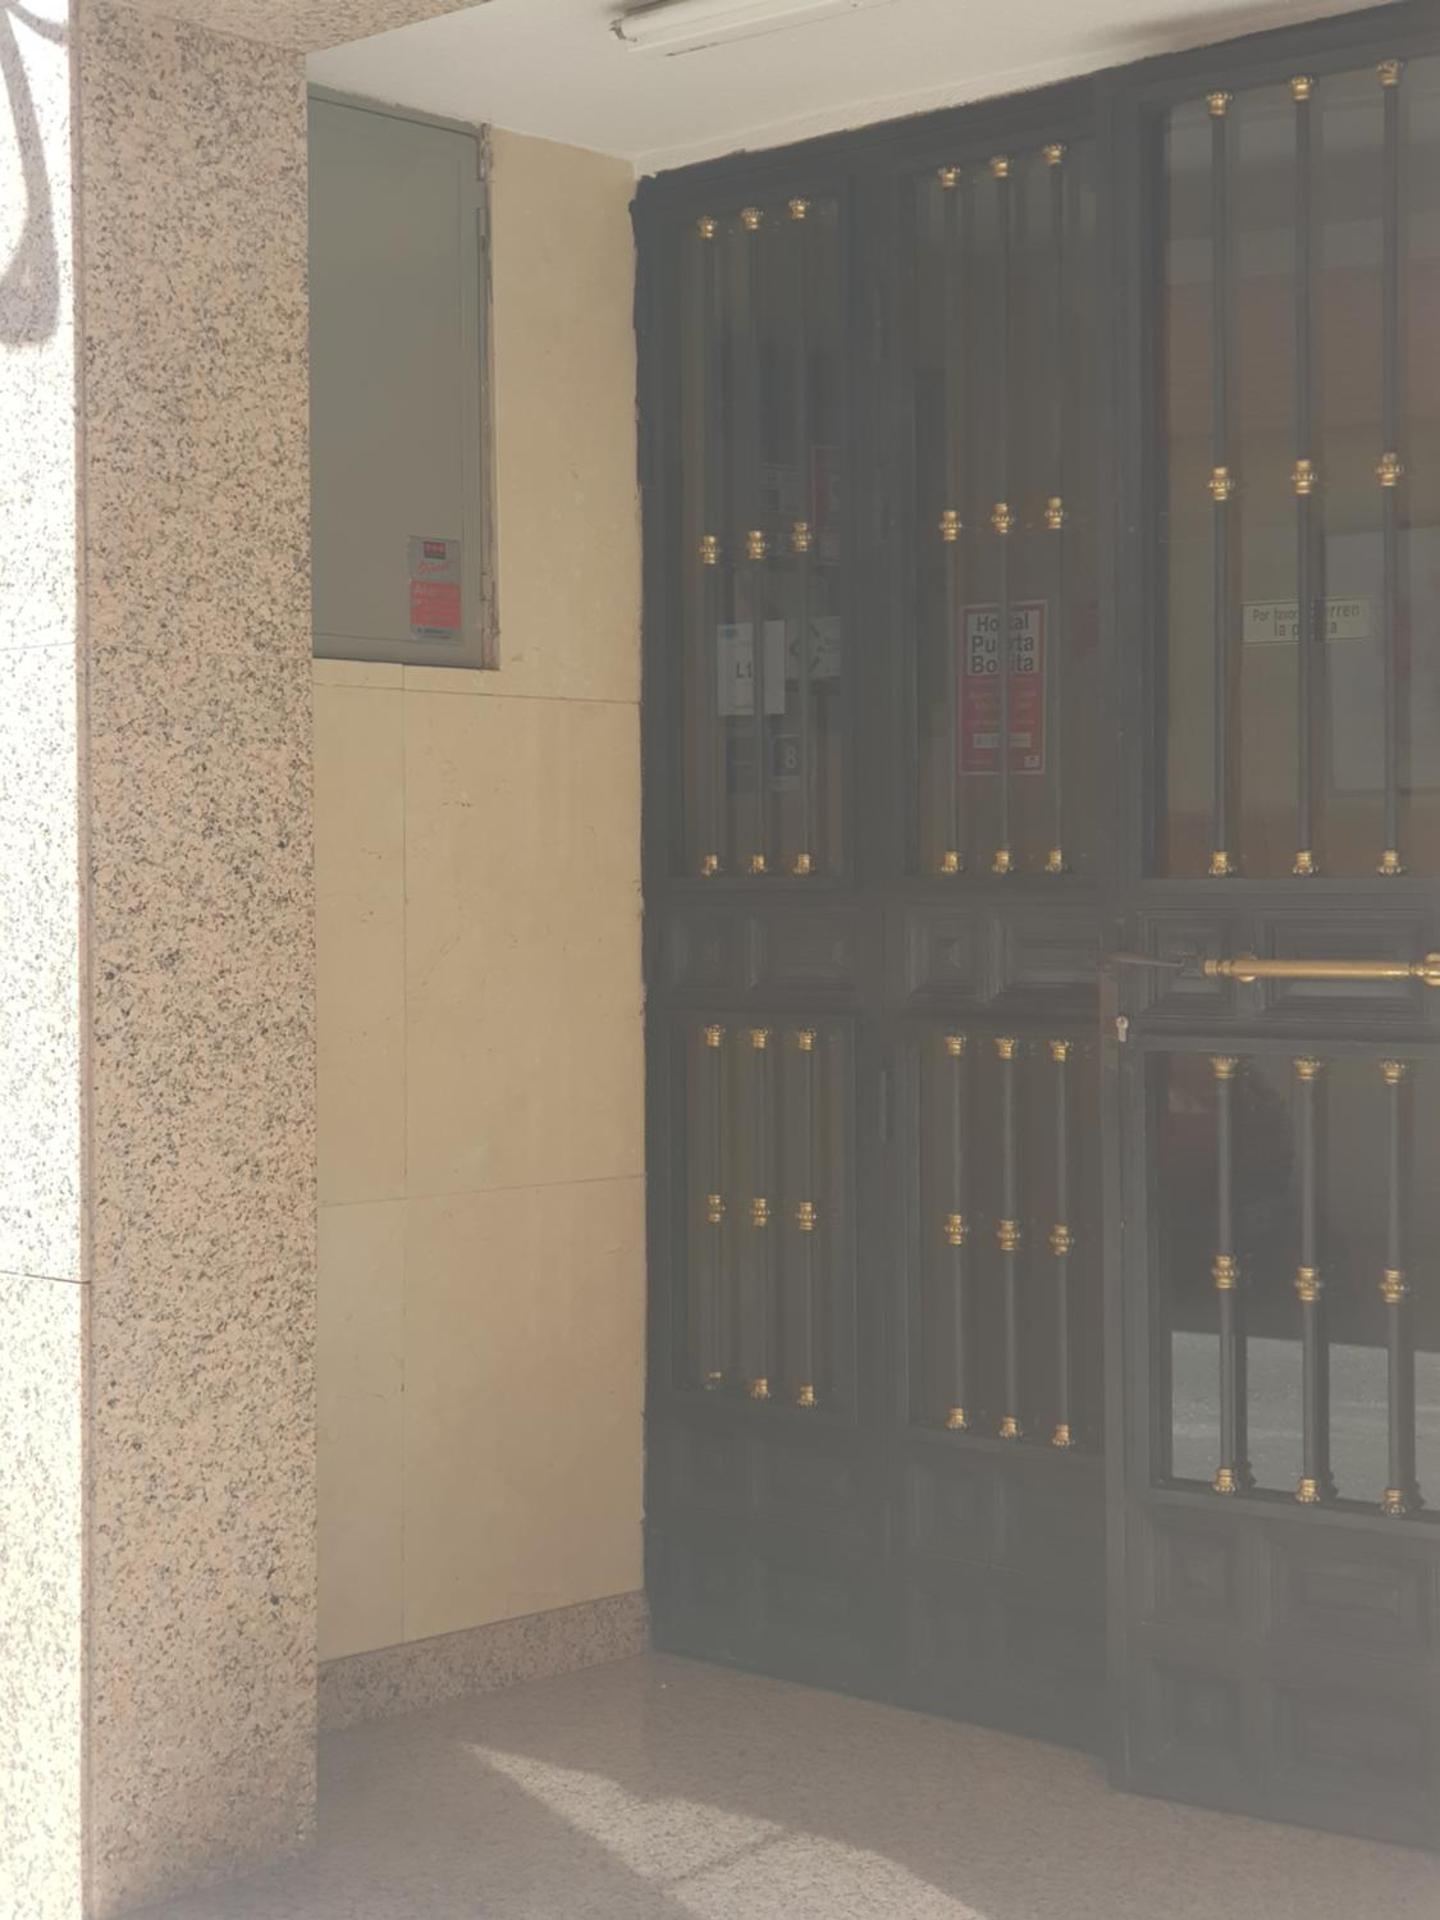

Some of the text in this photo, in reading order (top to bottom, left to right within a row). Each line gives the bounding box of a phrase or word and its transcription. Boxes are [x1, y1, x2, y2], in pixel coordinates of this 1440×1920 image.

[976, 612, 1029, 632] Hoal
[971, 634, 1034, 653] Purta
[971, 654, 1034, 674] Boita
